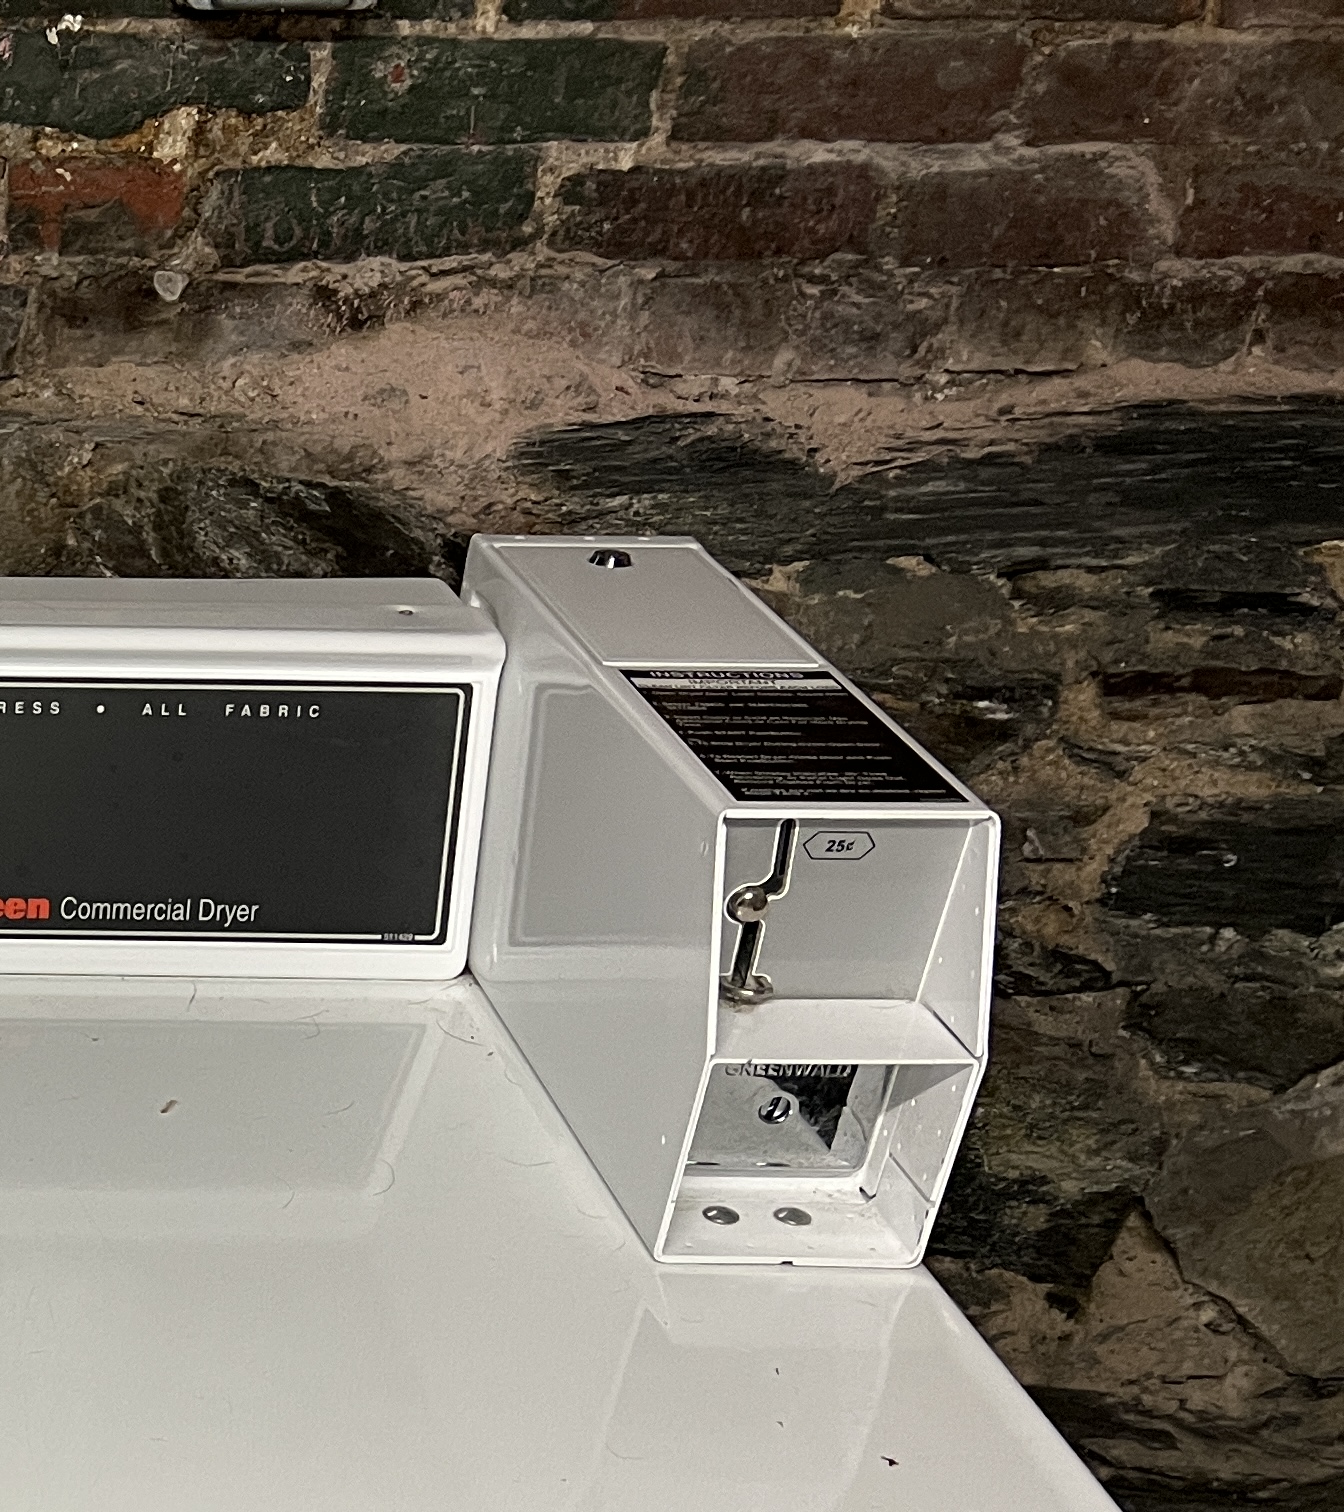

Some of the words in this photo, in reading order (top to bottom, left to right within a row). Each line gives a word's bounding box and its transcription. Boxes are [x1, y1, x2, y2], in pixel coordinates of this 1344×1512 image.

[141, 703, 189, 717] ALL
[224, 704, 322, 718] FABRIC
[824, 838, 857, 854] 25¢
[59, 896, 192, 922] Commercial
[198, 898, 261, 926] Dryer
